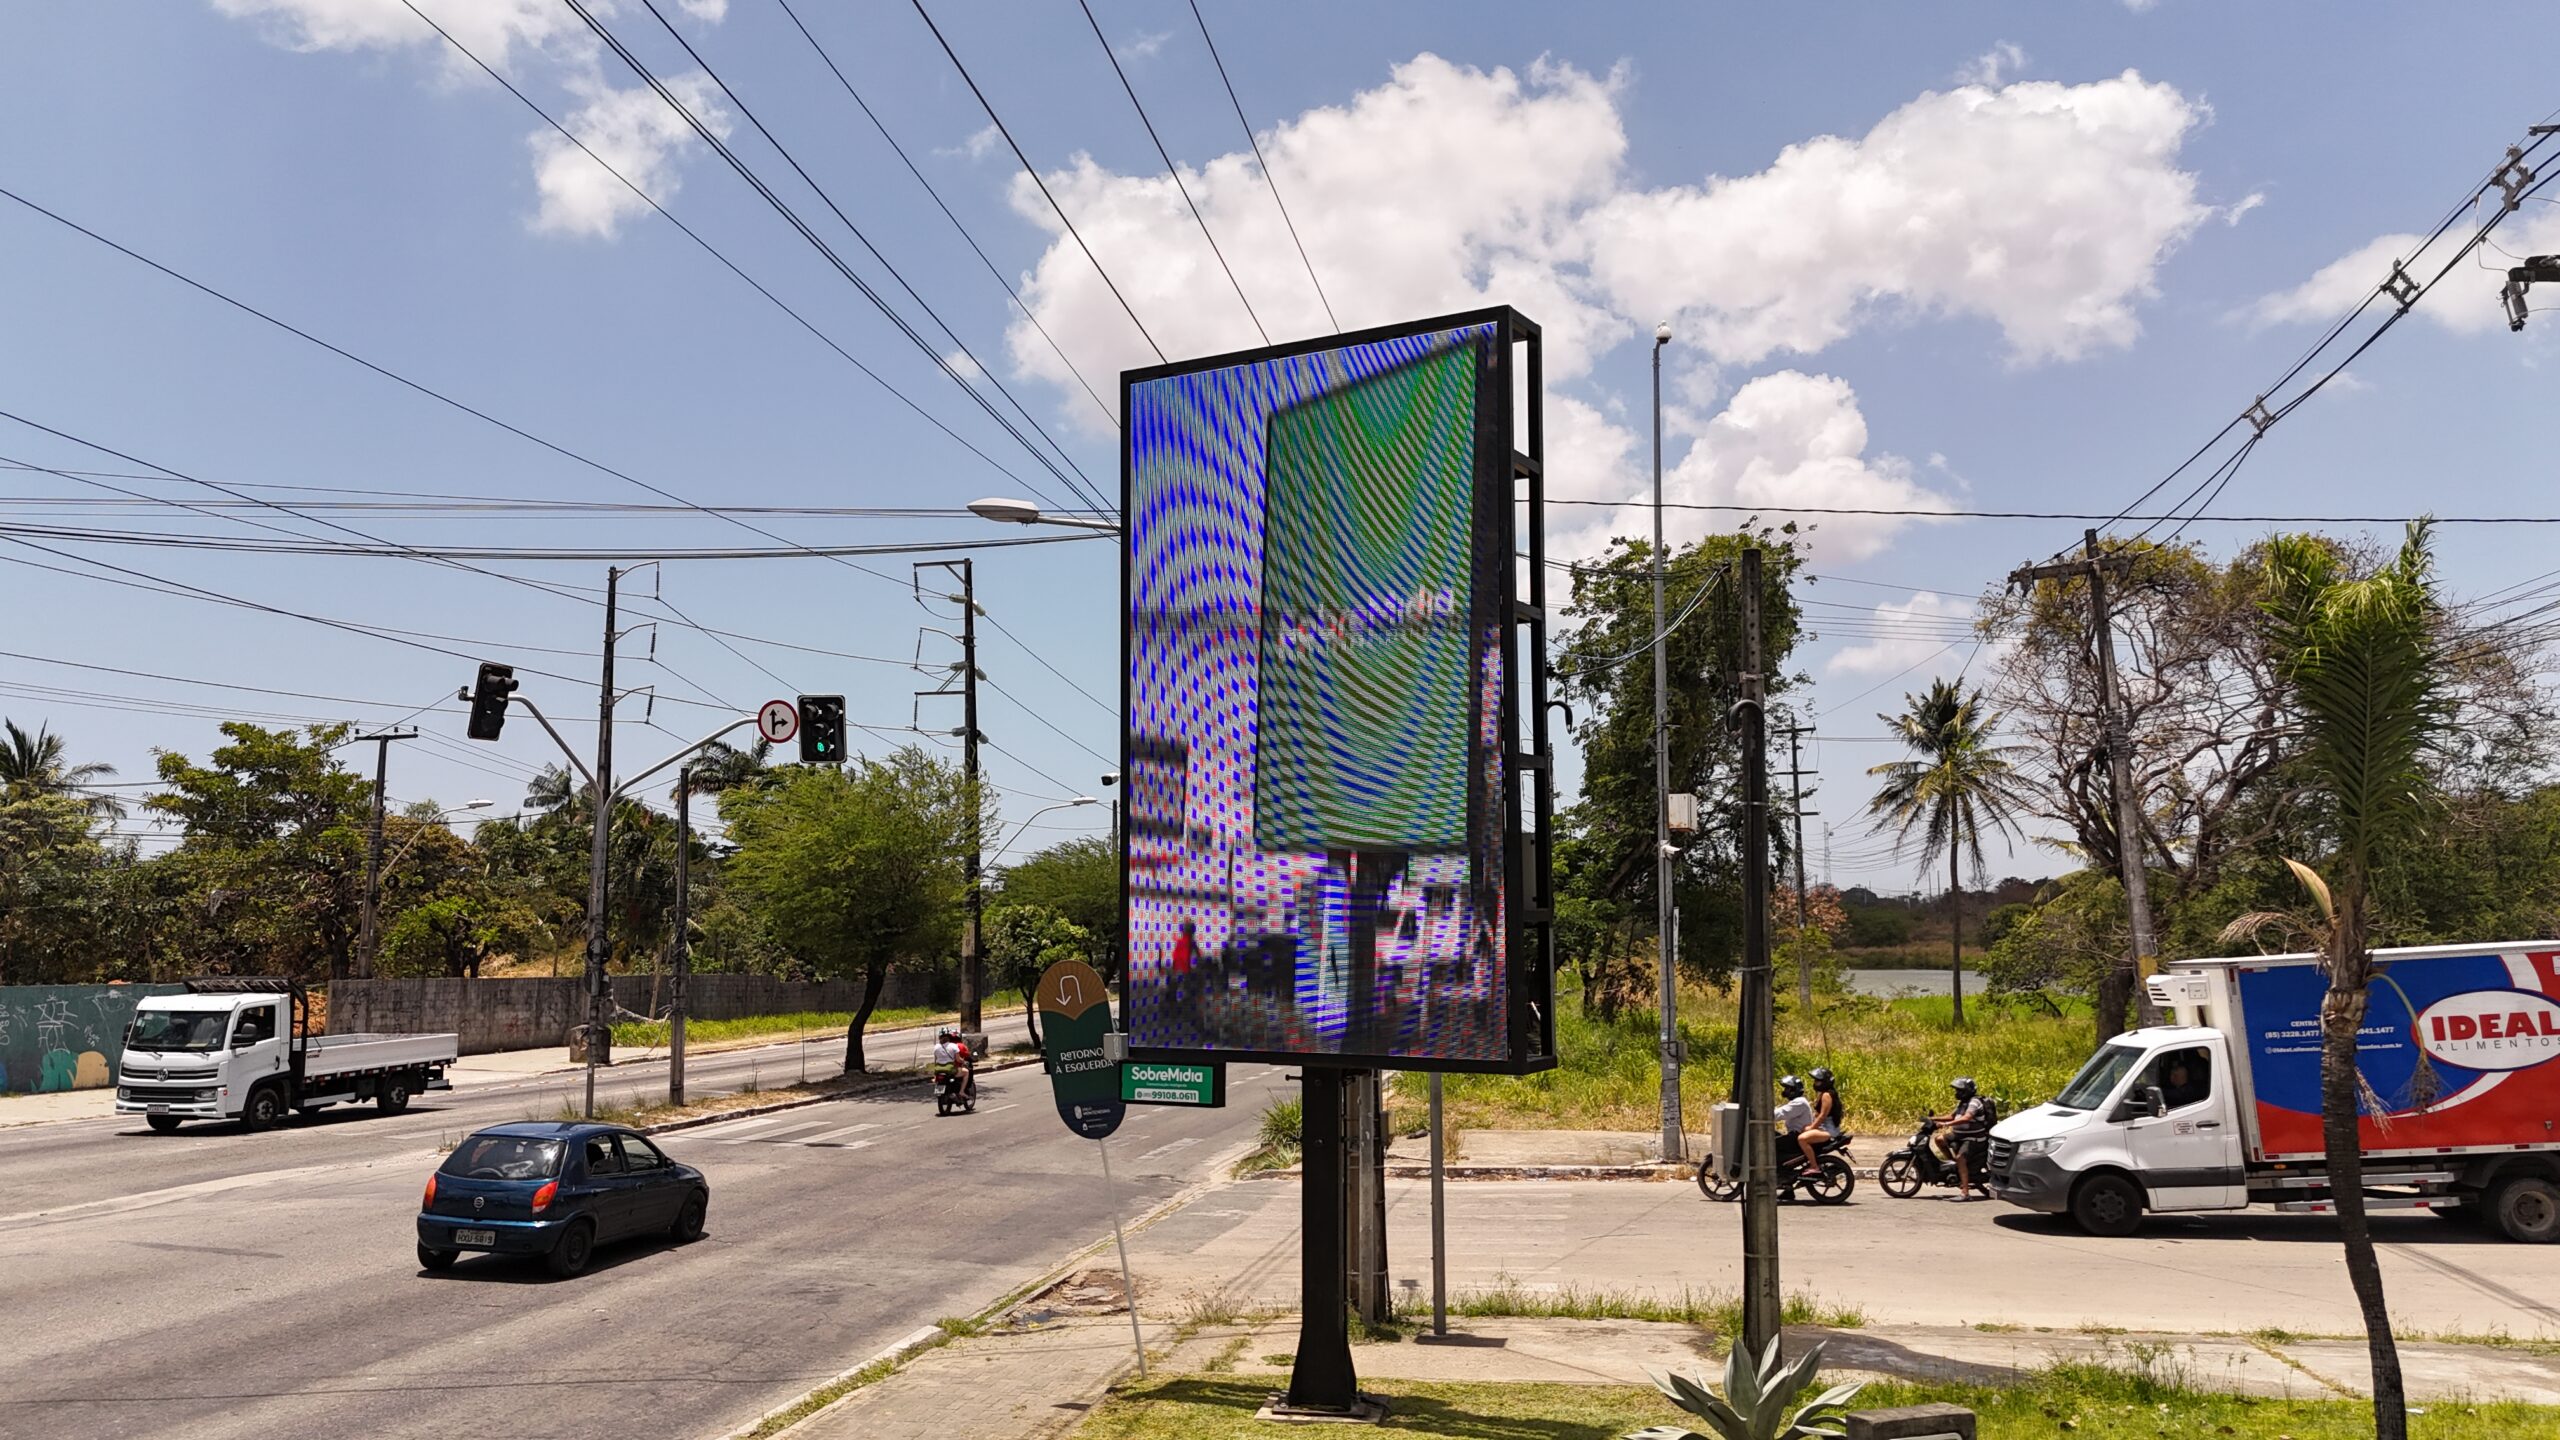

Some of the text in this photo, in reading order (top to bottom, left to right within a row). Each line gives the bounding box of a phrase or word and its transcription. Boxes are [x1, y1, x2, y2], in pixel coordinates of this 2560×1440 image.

[2431, 1011, 2560, 1041] IDEAL
[1065, 1059, 1114, 1073] ESQUERDA
[1152, 1091, 1197, 1101] 99108.0611
